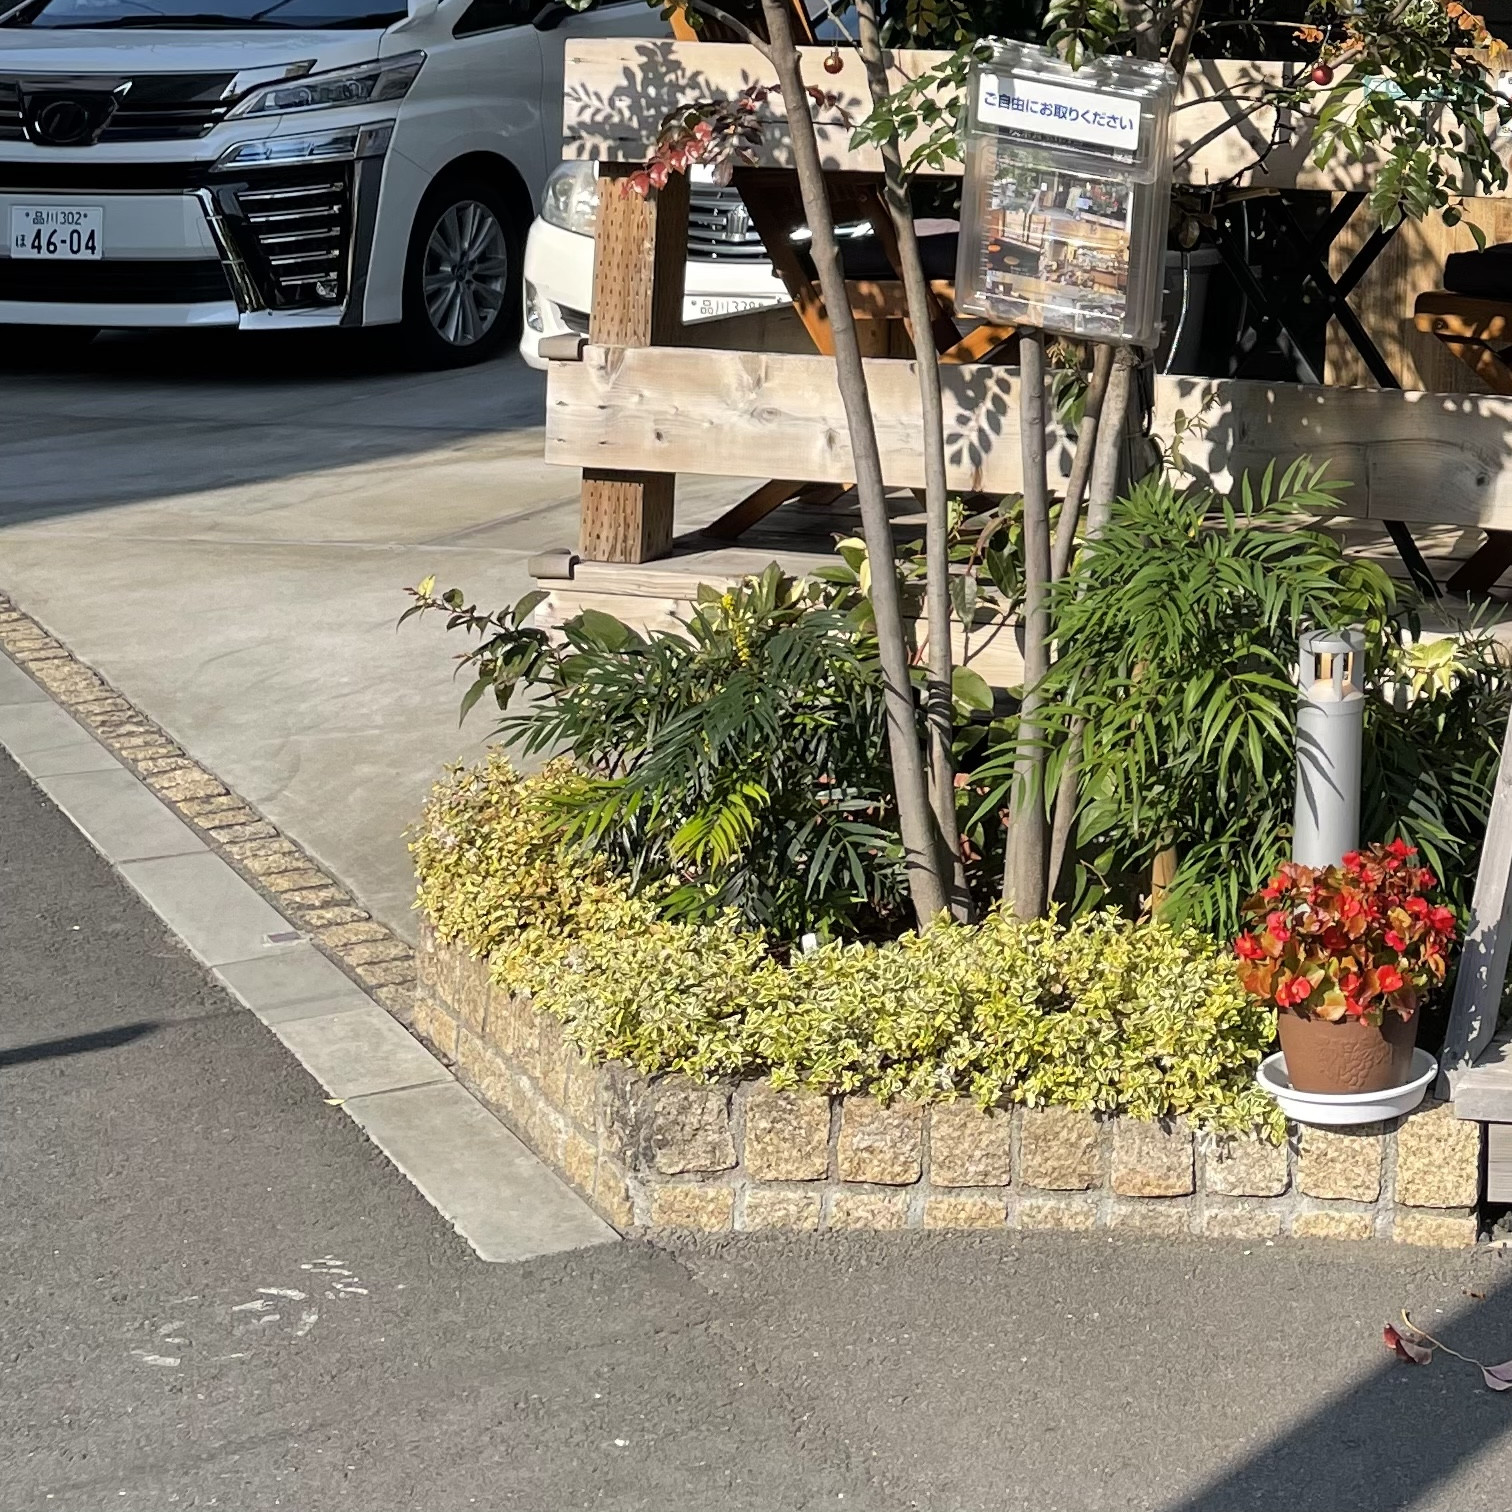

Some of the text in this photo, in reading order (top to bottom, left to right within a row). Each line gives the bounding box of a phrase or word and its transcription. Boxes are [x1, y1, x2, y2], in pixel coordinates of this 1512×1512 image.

[984, 92, 1134, 130] ご自由にお取りください
[15, 228, 97, 255] ほ 46-04
